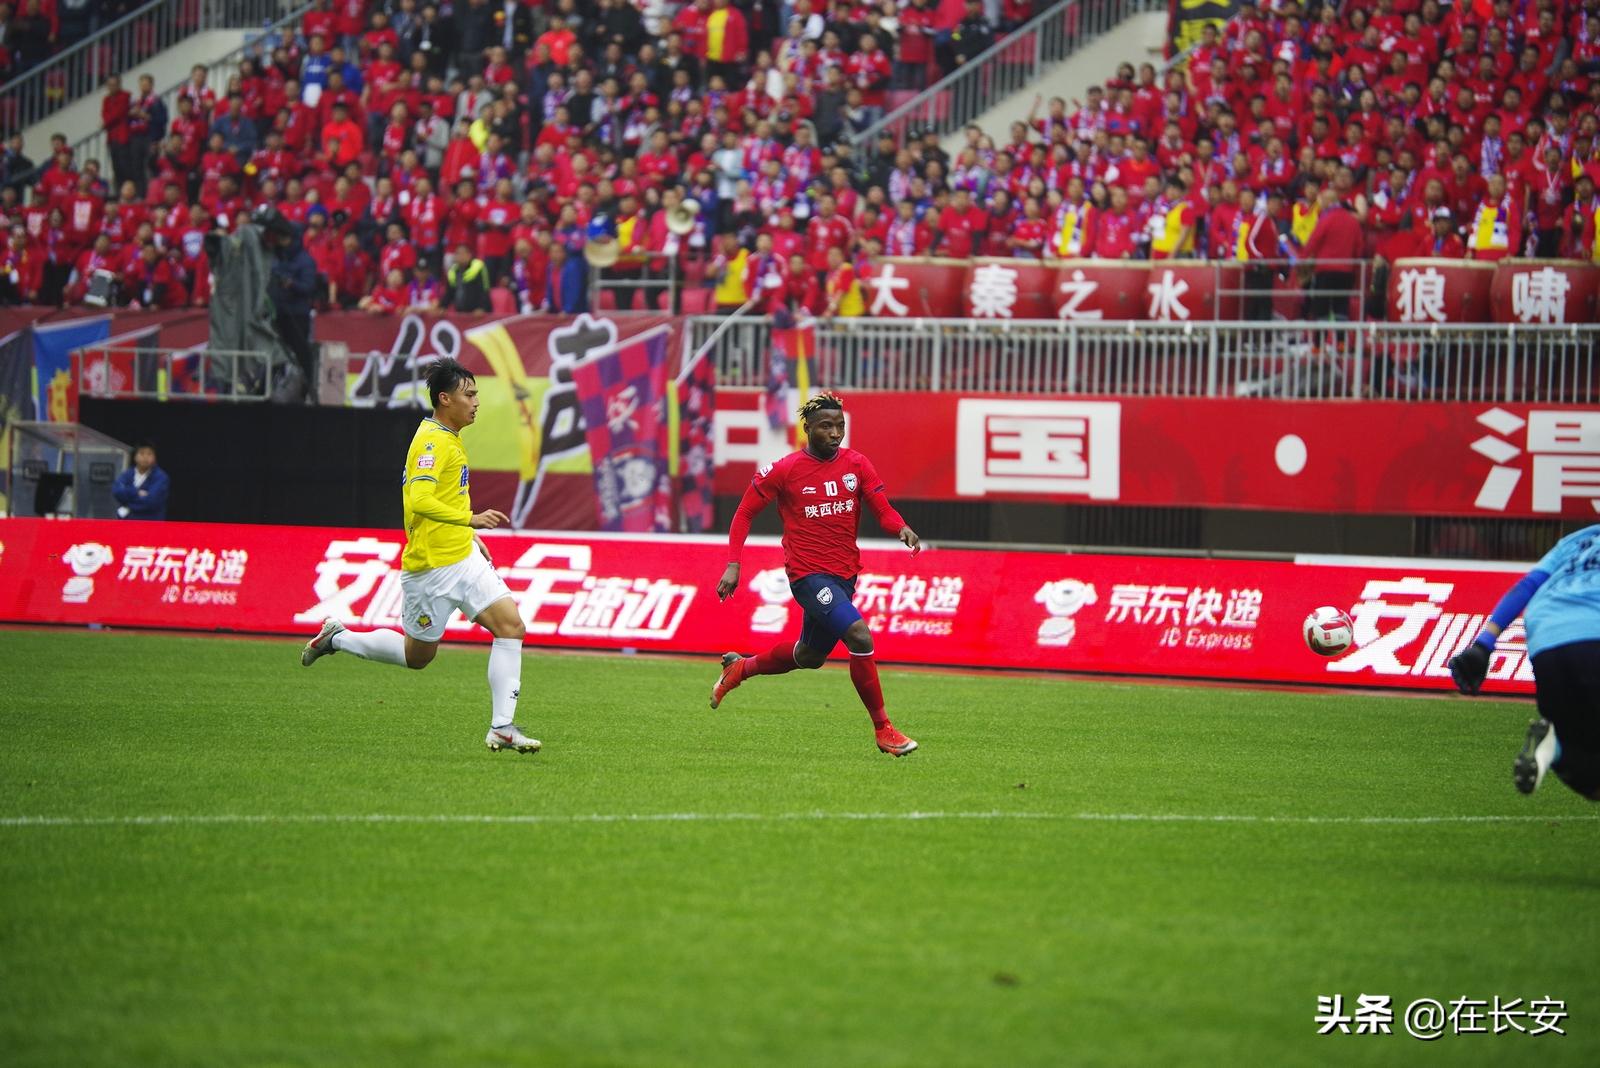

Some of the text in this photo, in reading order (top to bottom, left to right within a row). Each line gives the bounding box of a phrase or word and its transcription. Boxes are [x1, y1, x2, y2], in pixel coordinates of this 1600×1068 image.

[870, 263, 1190, 320] 大秦之水
[823, 480, 838, 497] 10
[117, 545, 249, 585] 京东快递
[182, 584, 238, 605] Express
[851, 573, 965, 616] 东快递
[1104, 584, 1264, 629] 京东快递
[889, 614, 954, 636] Express
[1184, 628, 1253, 650] Express
